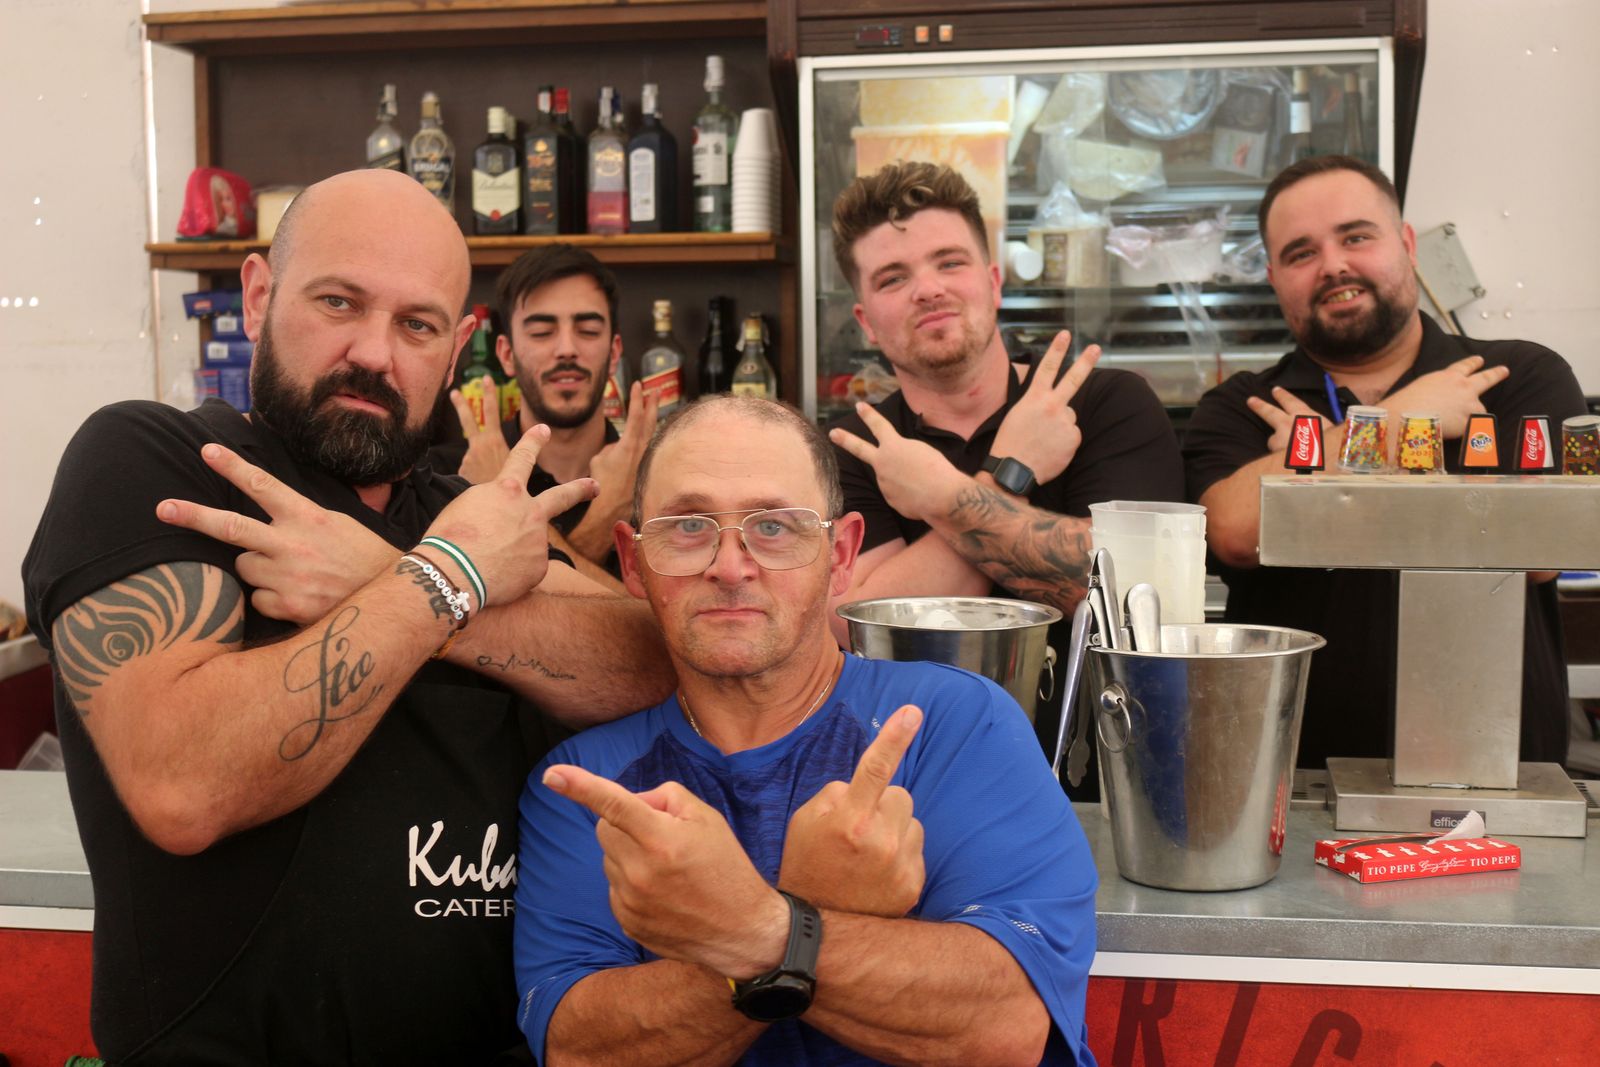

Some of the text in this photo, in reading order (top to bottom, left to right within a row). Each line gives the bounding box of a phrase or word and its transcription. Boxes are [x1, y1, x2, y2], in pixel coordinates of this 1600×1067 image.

[1433, 816, 1461, 828] effic
[408, 820, 518, 892] Kuba
[1367, 865, 1387, 876] TIO
[1390, 863, 1416, 874] PEPE
[1470, 857, 1489, 867] TIO
[1491, 855, 1517, 865] PEPE
[414, 898, 516, 918] CATER
